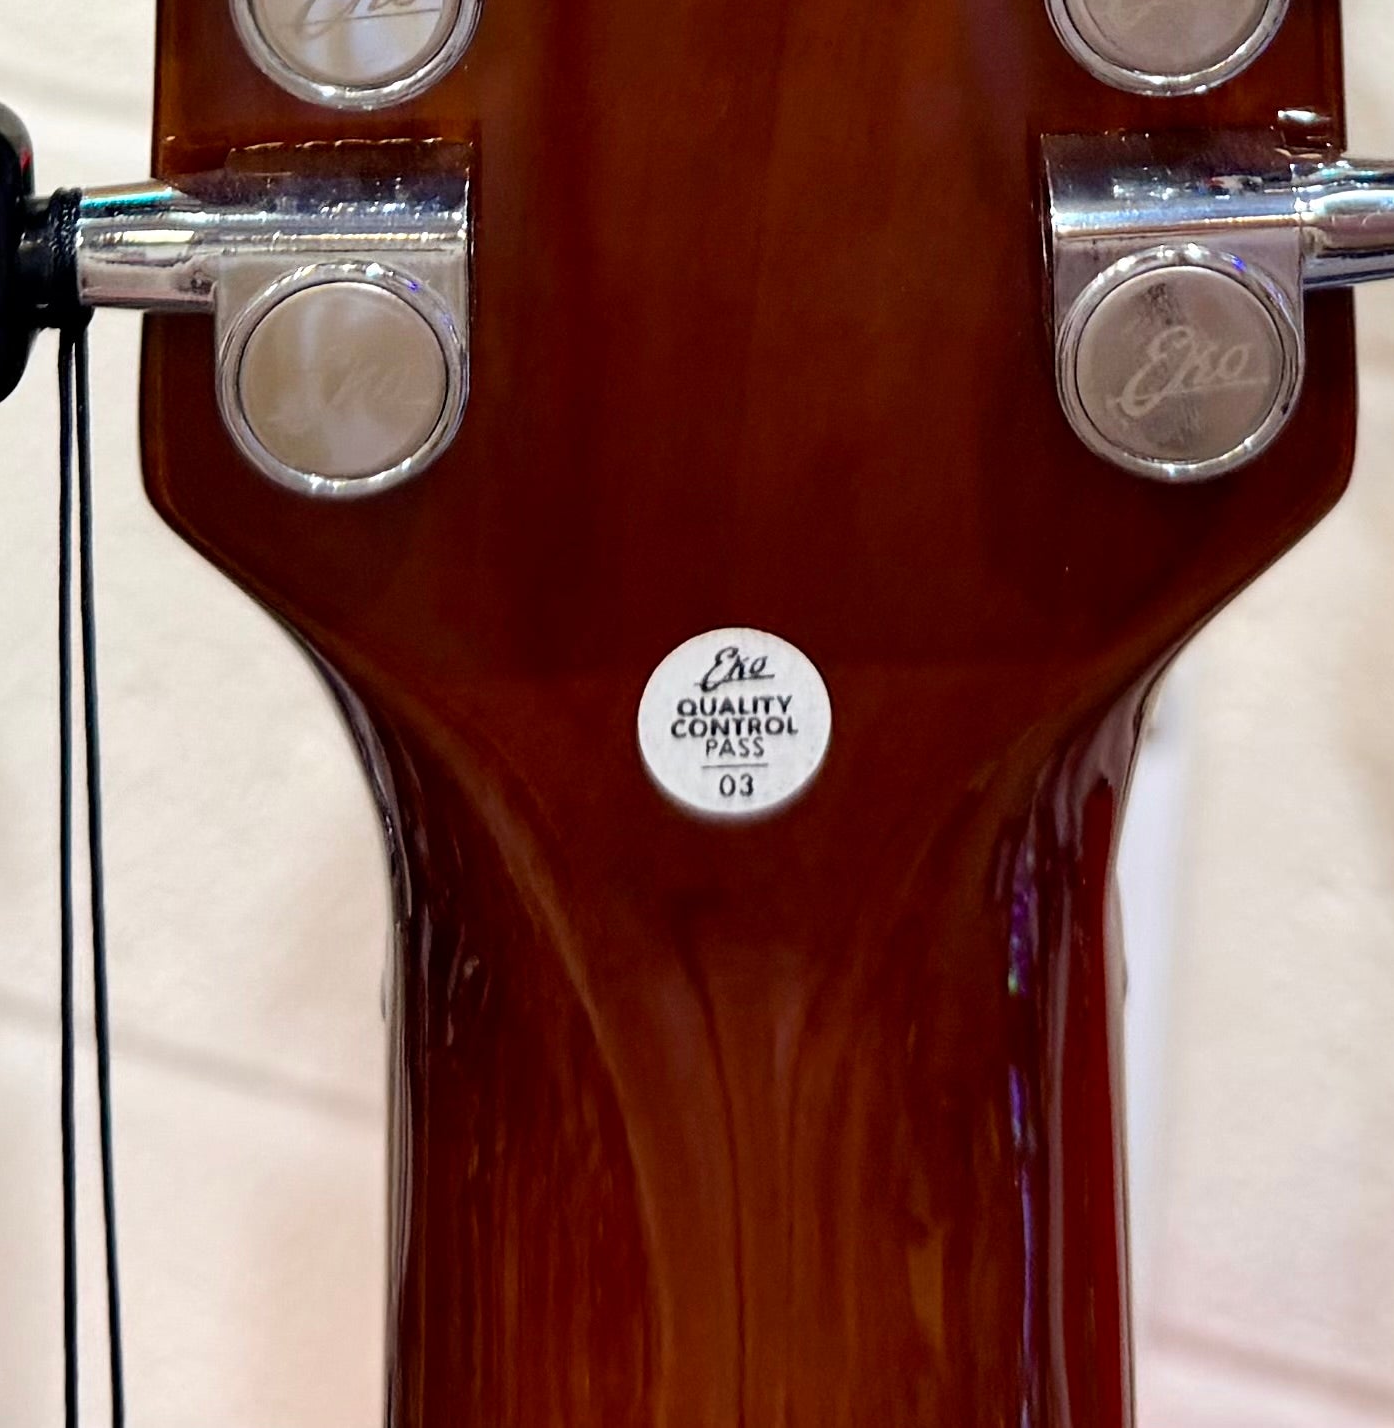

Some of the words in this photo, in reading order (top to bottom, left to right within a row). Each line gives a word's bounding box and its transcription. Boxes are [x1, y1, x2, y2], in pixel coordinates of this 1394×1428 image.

[1113, 325, 1270, 418] Eko
[694, 646, 776, 692] Eko
[676, 695, 793, 717] QUALITY
[670, 716, 799, 739] CONTROL
[705, 736, 765, 758] PASS
[719, 773, 754, 797] 03
